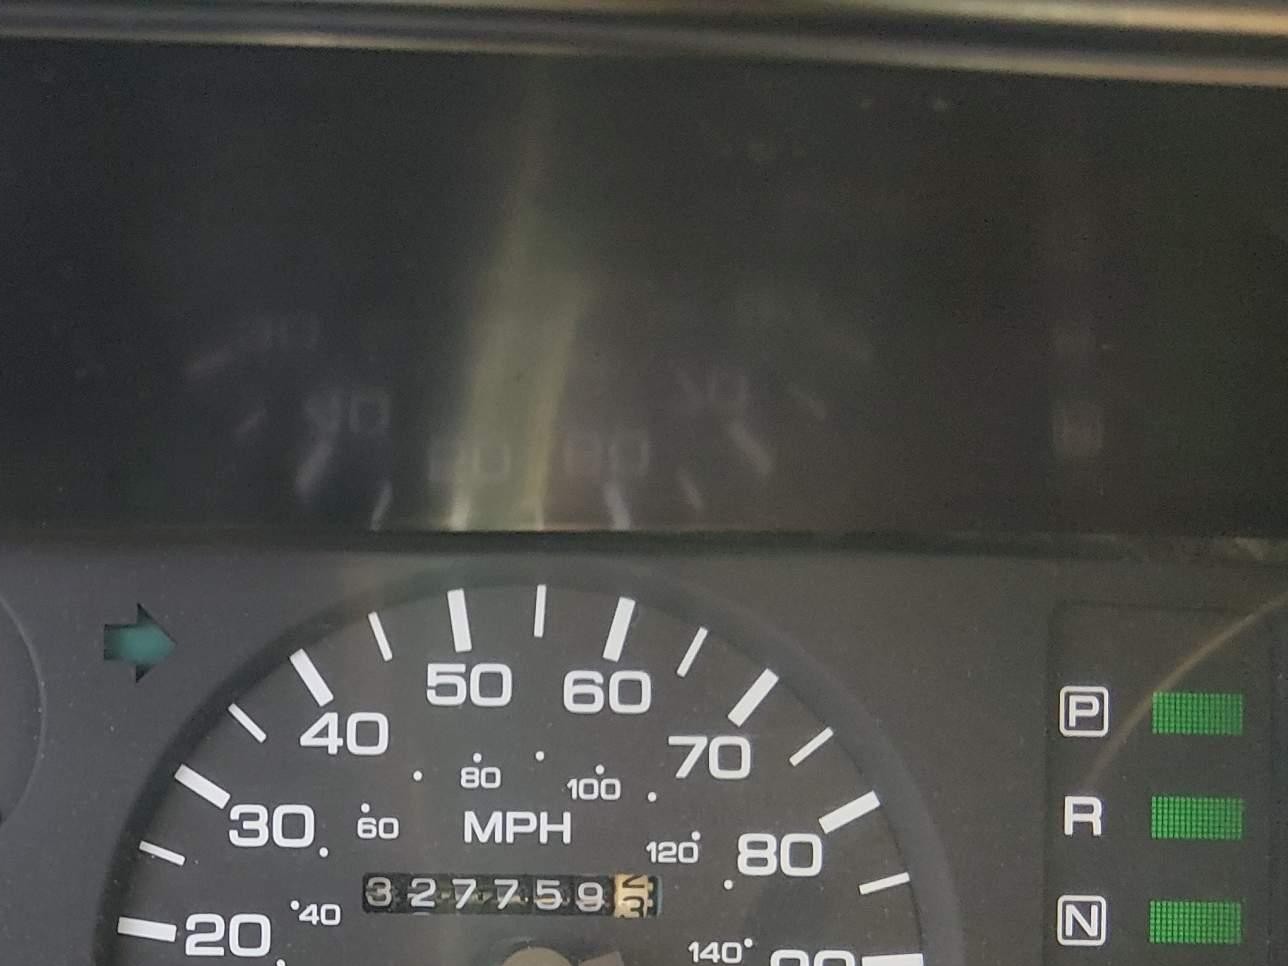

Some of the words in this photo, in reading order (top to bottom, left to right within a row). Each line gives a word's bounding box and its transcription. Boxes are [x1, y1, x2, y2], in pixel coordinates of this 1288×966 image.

[426, 663, 513, 707] 50
[563, 670, 652, 714] 60
[1069, 697, 1100, 728] P
[299, 711, 389, 755] 40
[668, 735, 751, 779] 70
[460, 766, 501, 789] 80
[566, 778, 621, 801] 100
[227, 803, 316, 849] 30
[357, 817, 399, 839] 60
[464, 810, 571, 844] MPH
[1064, 795, 1103, 836] R
[646, 841, 699, 865] 120
[737, 832, 823, 877] 80
[298, 903, 342, 926] 40
[1065, 904, 1098, 938] N
[185, 913, 271, 957] 20
[688, 941, 741, 964] 140
